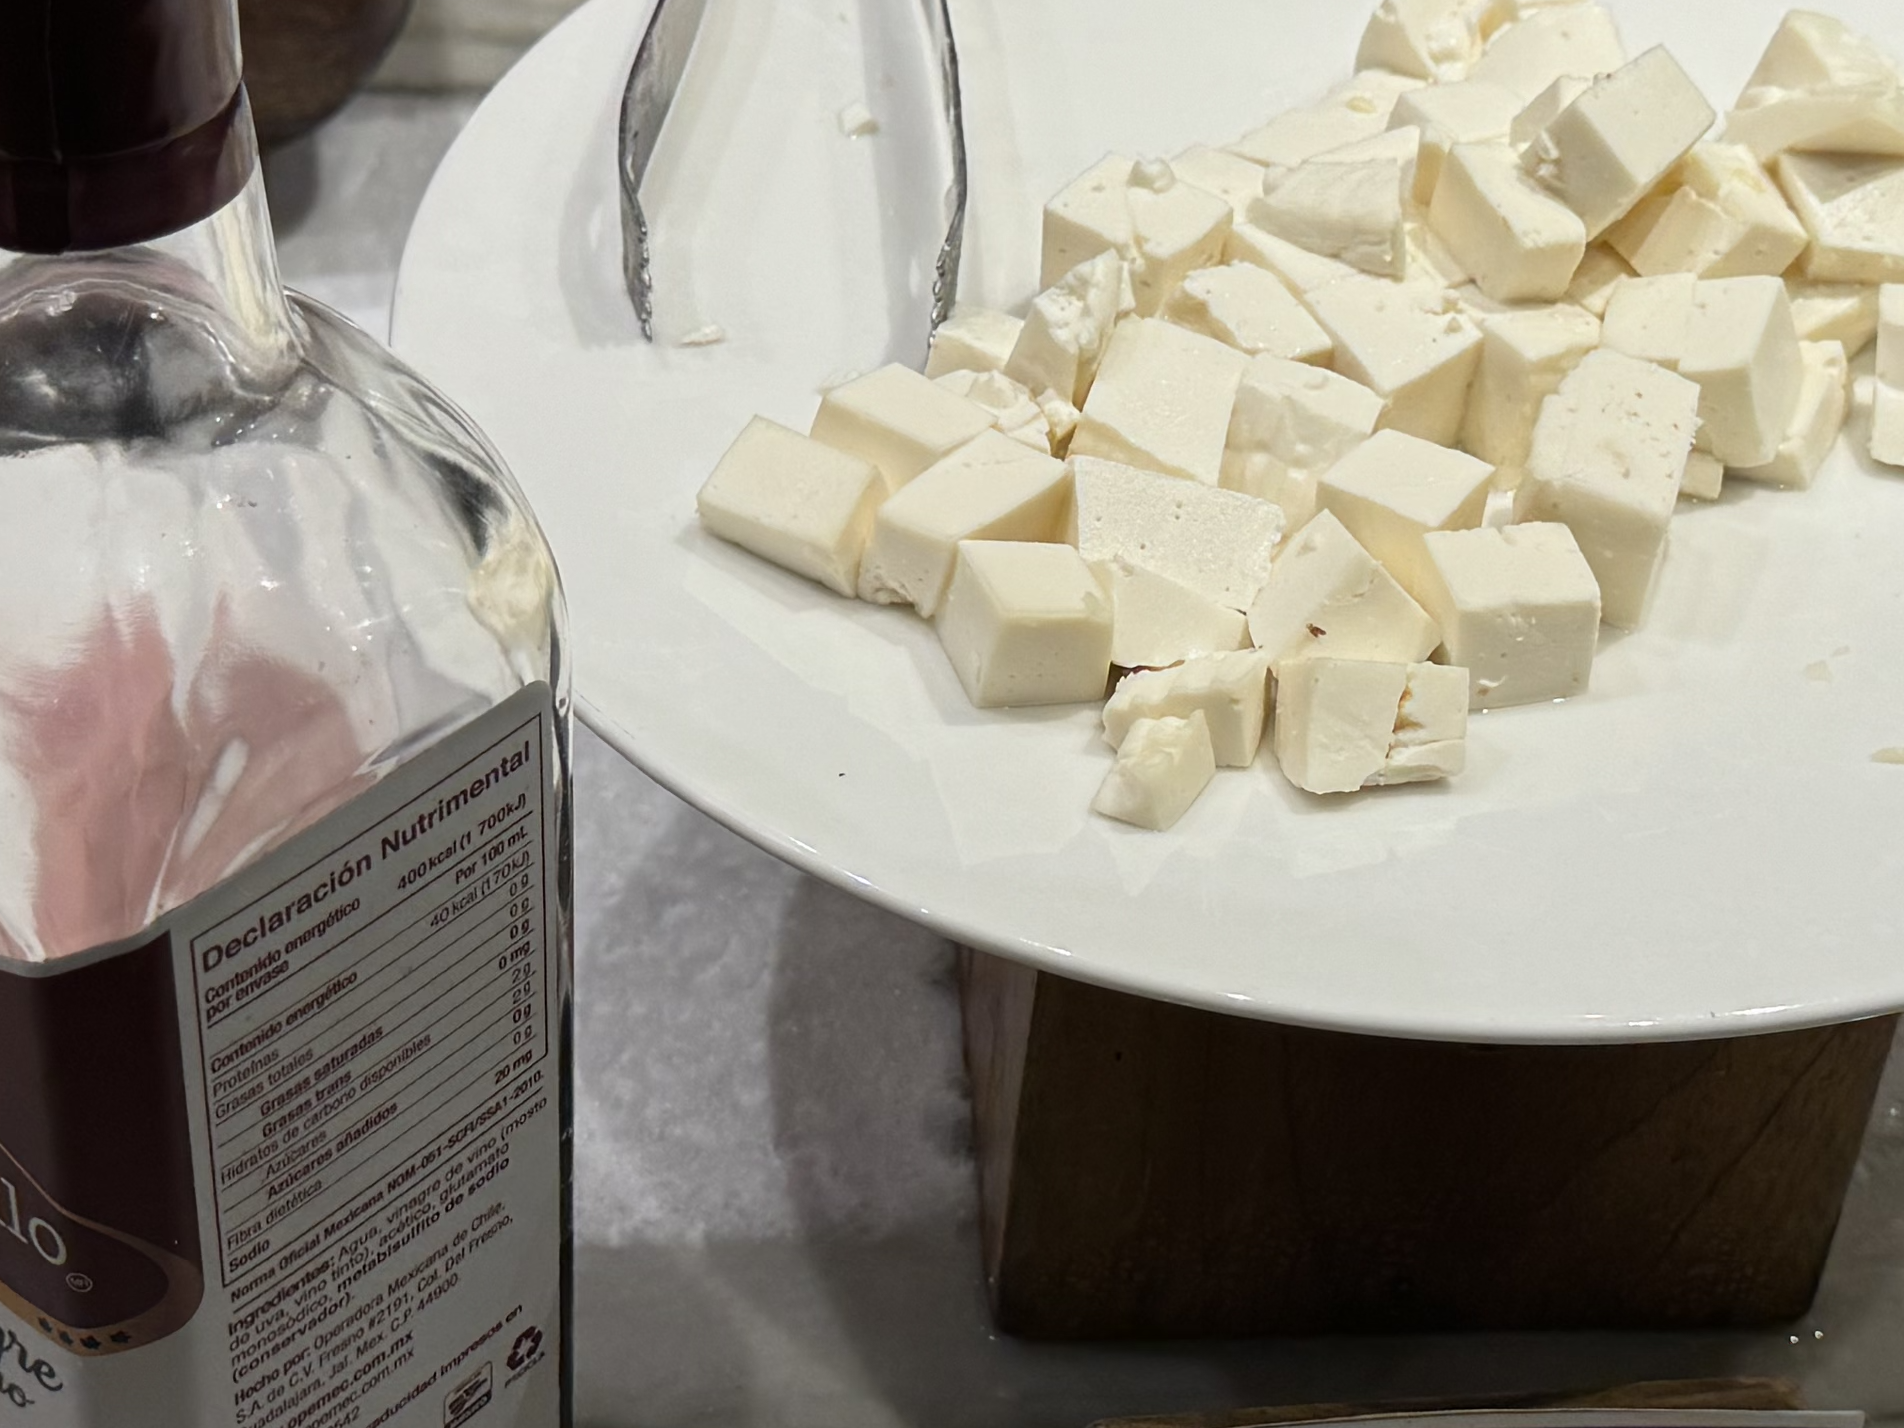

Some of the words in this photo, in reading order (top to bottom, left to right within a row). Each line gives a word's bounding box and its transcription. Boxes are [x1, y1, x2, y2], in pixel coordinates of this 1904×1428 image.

[202, 854, 372, 974] Declaración
[380, 740, 530, 861] Nutrimental
[455, 861, 478, 885] Por
[482, 840, 505, 866] 100
[204, 949, 282, 1005] Contenido
[284, 897, 361, 955] energético
[206, 994, 232, 1024] por
[235, 959, 290, 1002] envase
[210, 1021, 283, 1075] Contenido
[285, 971, 358, 1026] energético
[451, 886, 478, 916] kcal
[212, 1049, 280, 1098] Proteínas
[215, 1081, 264, 1120] Grasas
[267, 1048, 314, 1086] totales
[220, 1137, 279, 1186] Hidratos
[282, 1126, 300, 1144] de
[303, 1086, 357, 1131] carbono
[359, 1034, 431, 1092] disponibles
[259, 1076, 311, 1117] Grasas
[313, 1026, 384, 1081] saturadas
[262, 1098, 313, 1138] Grasas
[315, 1070, 352, 1103] trans
[265, 1130, 327, 1180] Azúcares
[267, 1148, 333, 1201] Azúcares
[336, 1102, 398, 1153] añadidos
[227, 1220, 262, 1251] Fibra
[265, 1179, 322, 1225] dietética
[227, 1255, 335, 1338] Ingredientes:
[386, 1179, 441, 1225] vinagre
[444, 1162, 463, 1183] de
[467, 1137, 497, 1164] vino
[501, 1097, 547, 1142] (mosto
[229, 1327, 251, 1352] de
[294, 1278, 327, 1307] vino
[439, 1142, 510, 1205] glutamato
[229, 1239, 270, 1273] Sodio
[230, 1267, 276, 1304] Norma
[278, 1233, 321, 1271] Oficial
[324, 1190, 384, 1241] Mexicana
[337, 1211, 440, 1294] metabisulfito
[444, 1193, 464, 1213] de
[468, 1157, 510, 1196] sodio
[234, 1368, 280, 1407] Hecho
[313, 1293, 383, 1351] Operadora
[387, 1244, 449, 1298] Mexicana
[452, 1229, 468, 1247] de
[440, 1320, 504, 1377] impresos
[505, 1304, 523, 1323] en
[266, 1384, 285, 1404] de
[318, 1326, 365, 1368] Fresno
